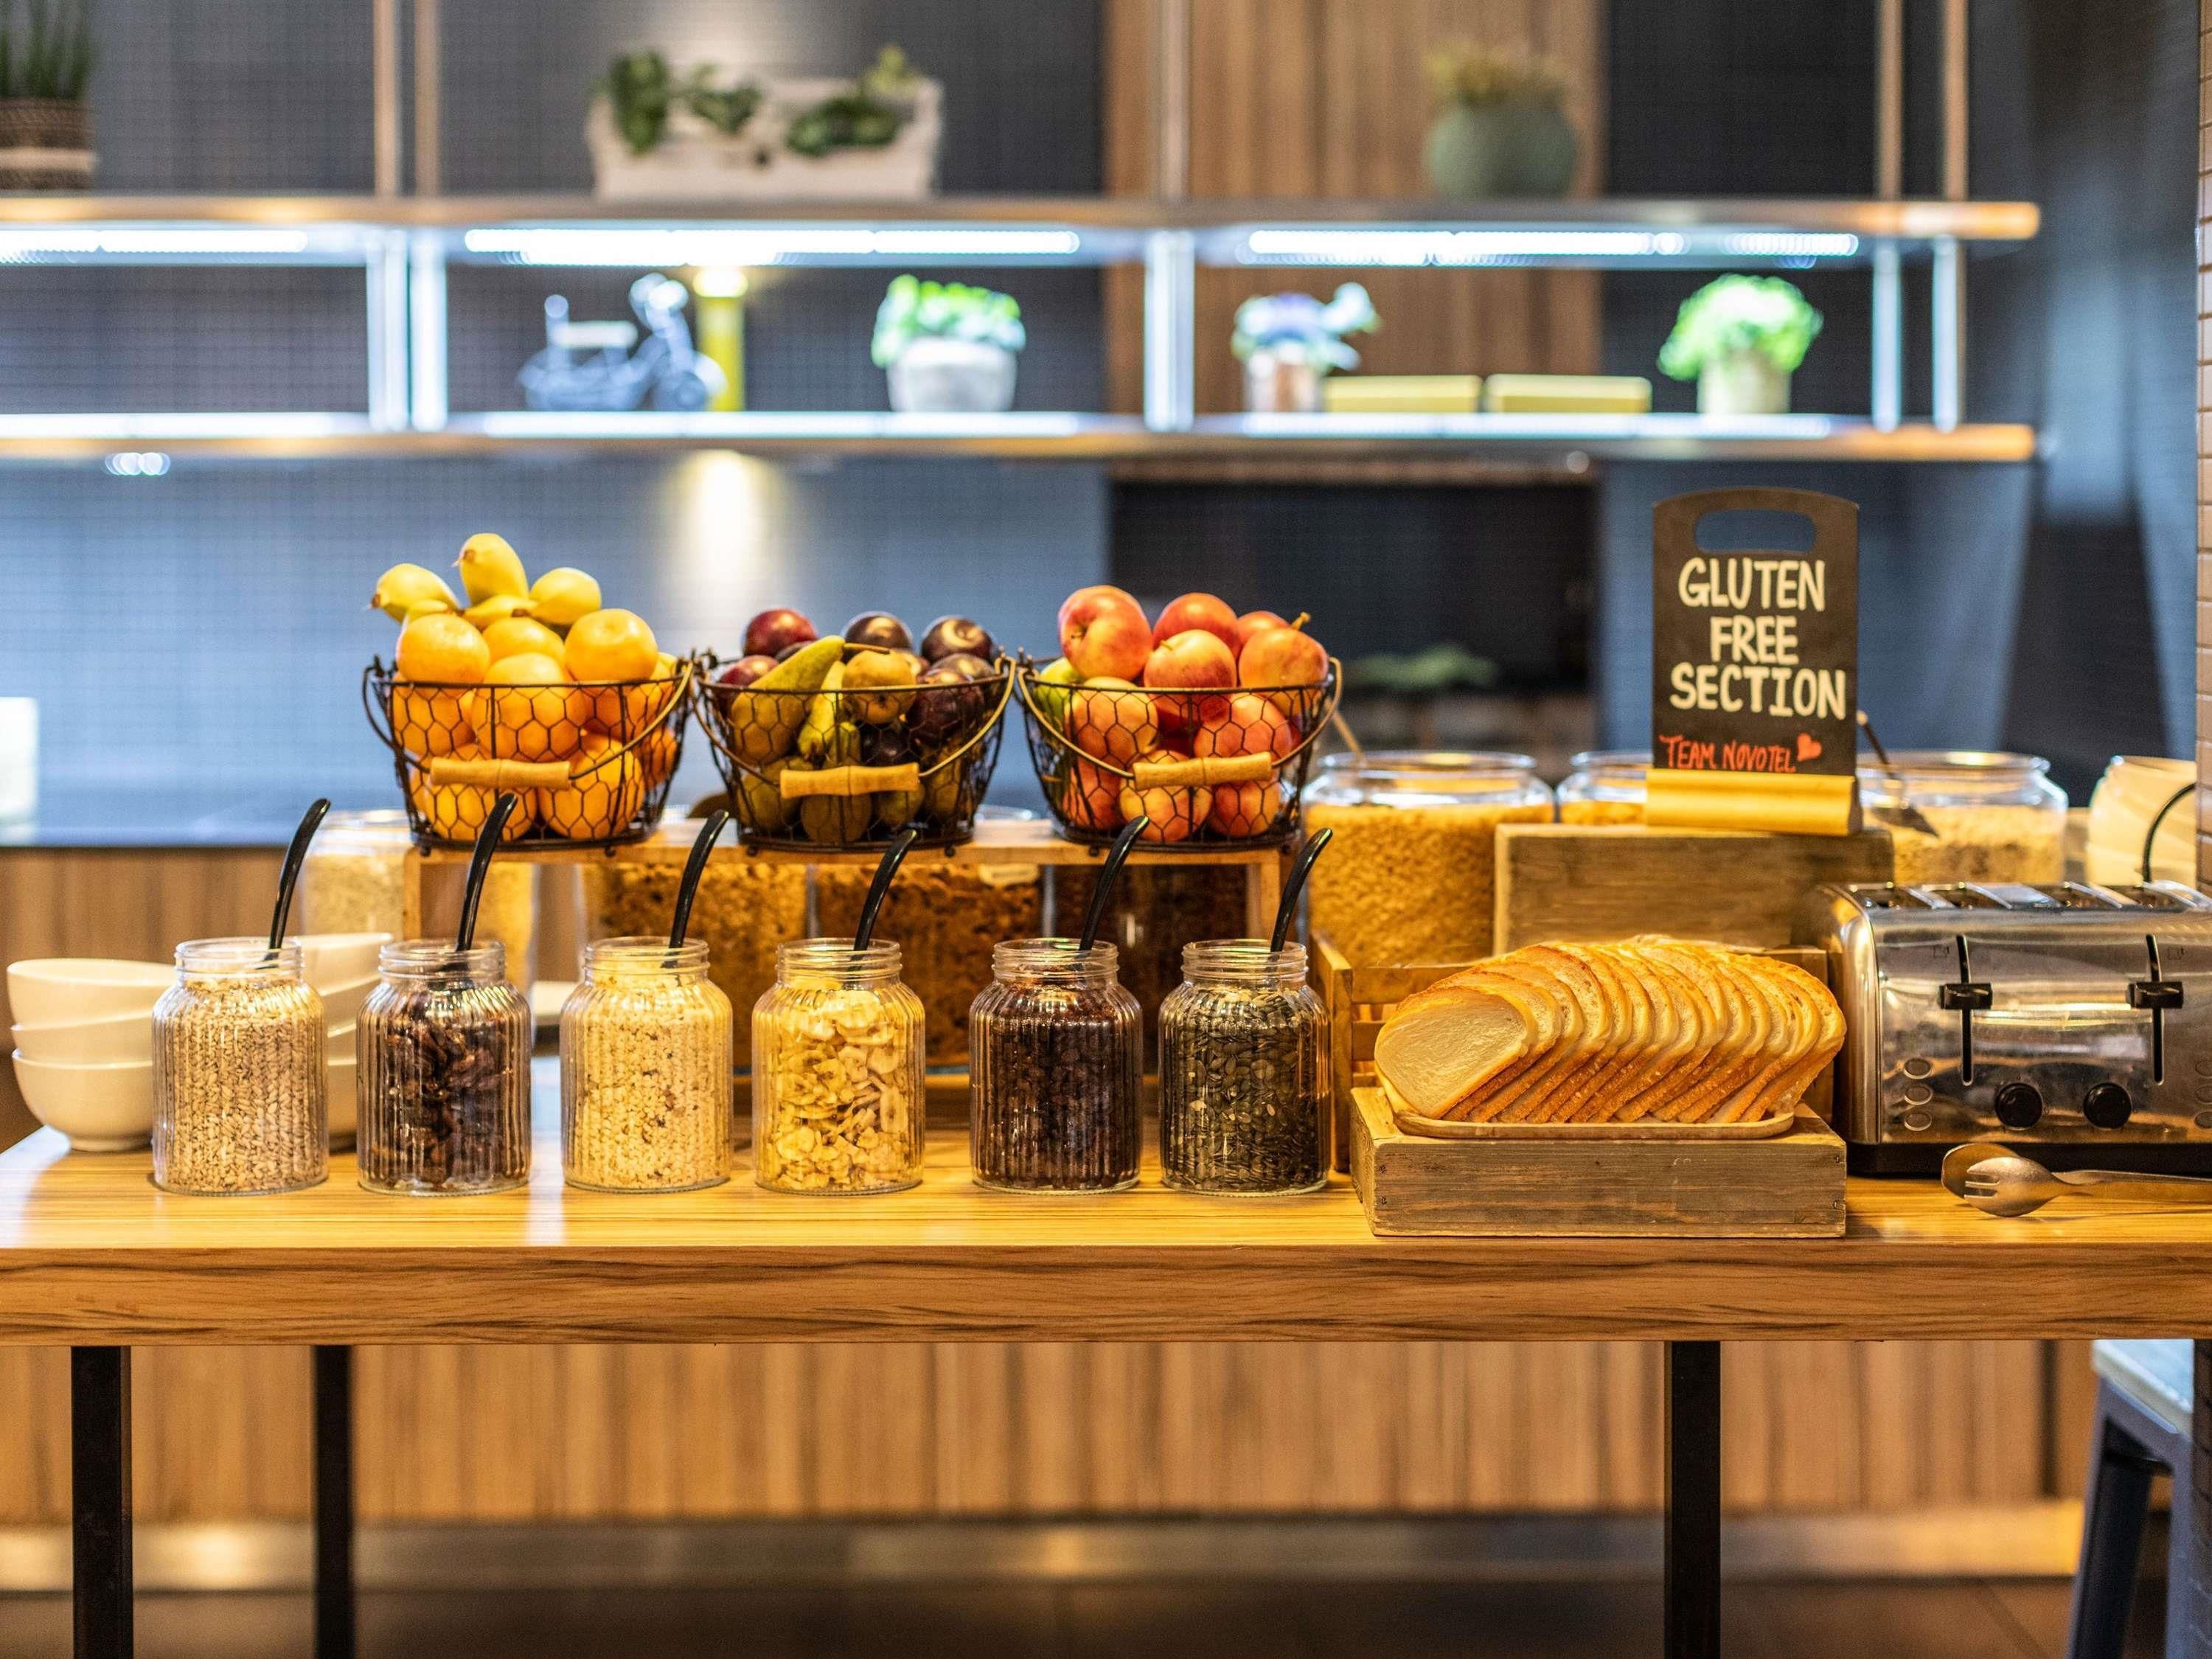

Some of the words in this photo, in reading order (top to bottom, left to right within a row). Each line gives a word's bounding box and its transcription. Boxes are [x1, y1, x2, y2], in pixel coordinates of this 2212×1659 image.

[1679, 557, 1825, 611] GLUTEN
[1710, 615, 1798, 664] FREE
[1670, 662, 1846, 719] SECTION
[1659, 734, 1717, 769] TEAM
[1722, 740, 1796, 773] NOVOTEL
